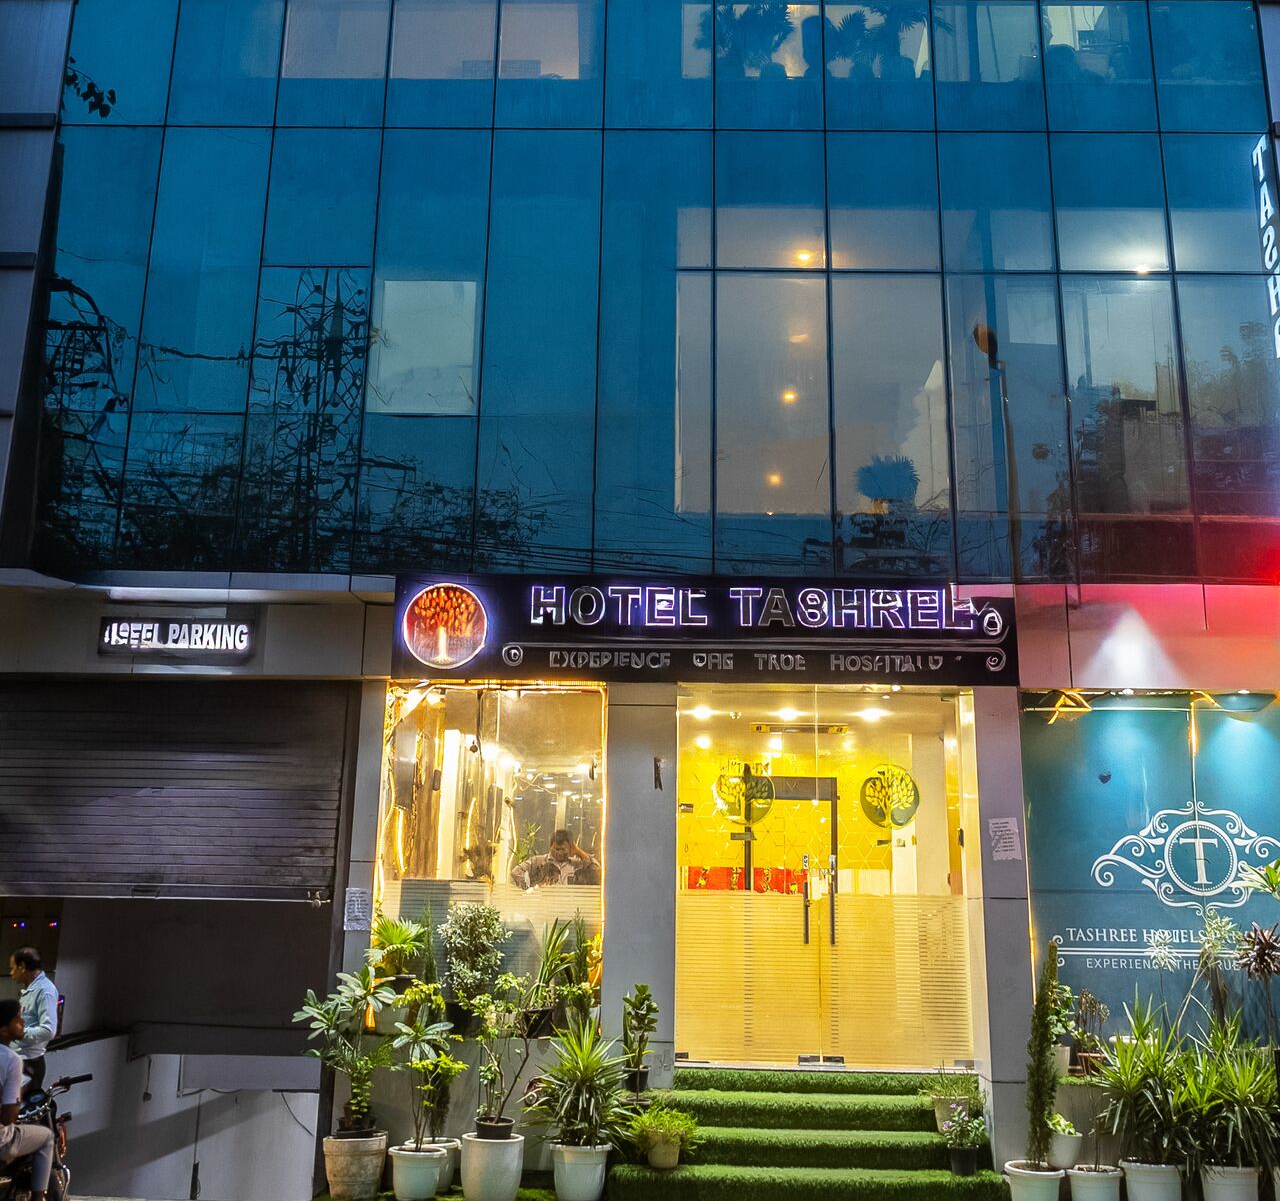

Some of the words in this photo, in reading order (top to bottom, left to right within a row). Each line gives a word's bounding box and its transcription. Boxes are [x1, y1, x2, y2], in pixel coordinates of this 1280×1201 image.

[530, 585, 708, 627] HOTEL
[169, 623, 249, 650] PARKING
[1179, 837, 1219, 885] T
[1066, 928, 1138, 942] TASHREE
